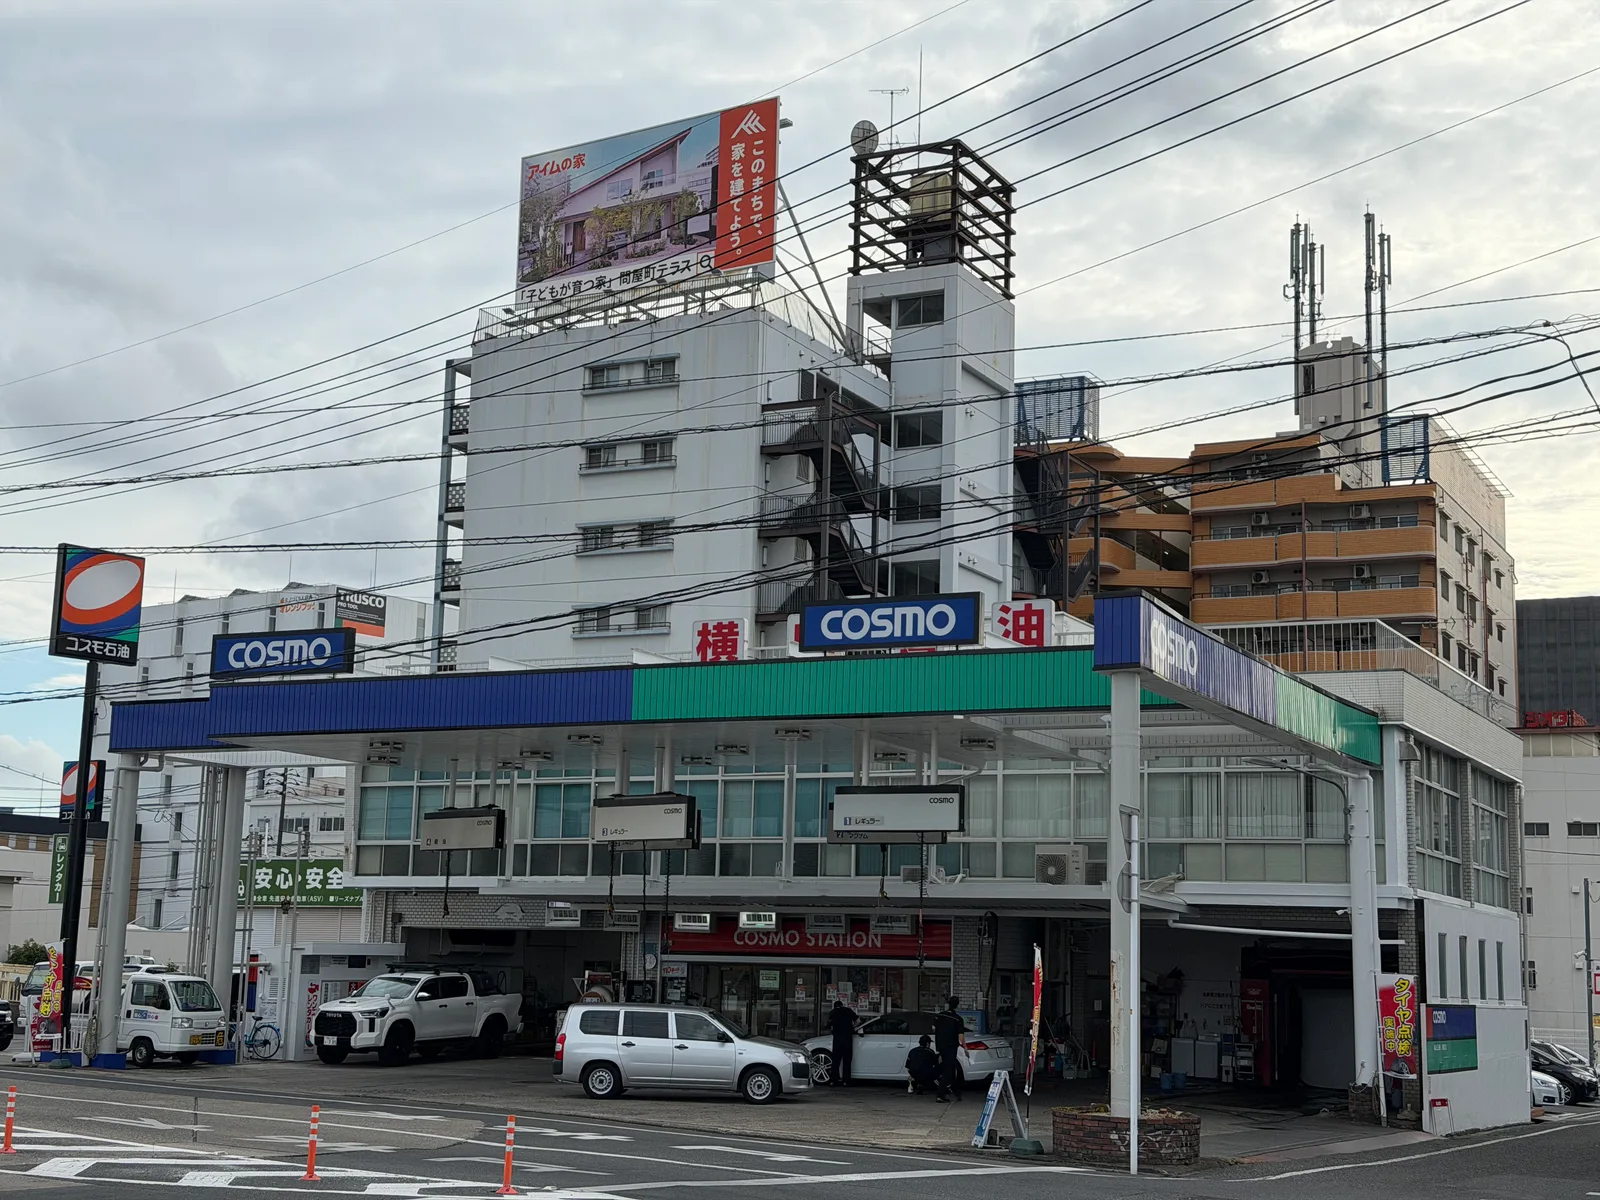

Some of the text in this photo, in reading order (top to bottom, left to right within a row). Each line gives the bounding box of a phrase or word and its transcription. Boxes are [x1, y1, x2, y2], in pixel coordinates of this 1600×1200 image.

[528, 153, 586, 181] アイムの家
[729, 142, 746, 255] 家を建てよう。
[750, 139, 765, 236] このまちで、
[520, 259, 691, 301] 「子どもが育つ家」 問屋町テラス
[338, 589, 384, 608] TRUSCO
[696, 603, 1044, 662] 横 油
[820, 603, 956, 640] COSMO
[65, 636, 130, 659] コスモ石油
[228, 637, 332, 669] COSMO
[1151, 619, 1198, 676] COSMO
[54, 853, 65, 902] レンタカー
[254, 867, 344, 889] 安心・安全
[733, 930, 882, 948] COSMO STATION
[1383, 1017, 1396, 1052] 実施中
[1394, 978, 1412, 1056] タイヤ点検
